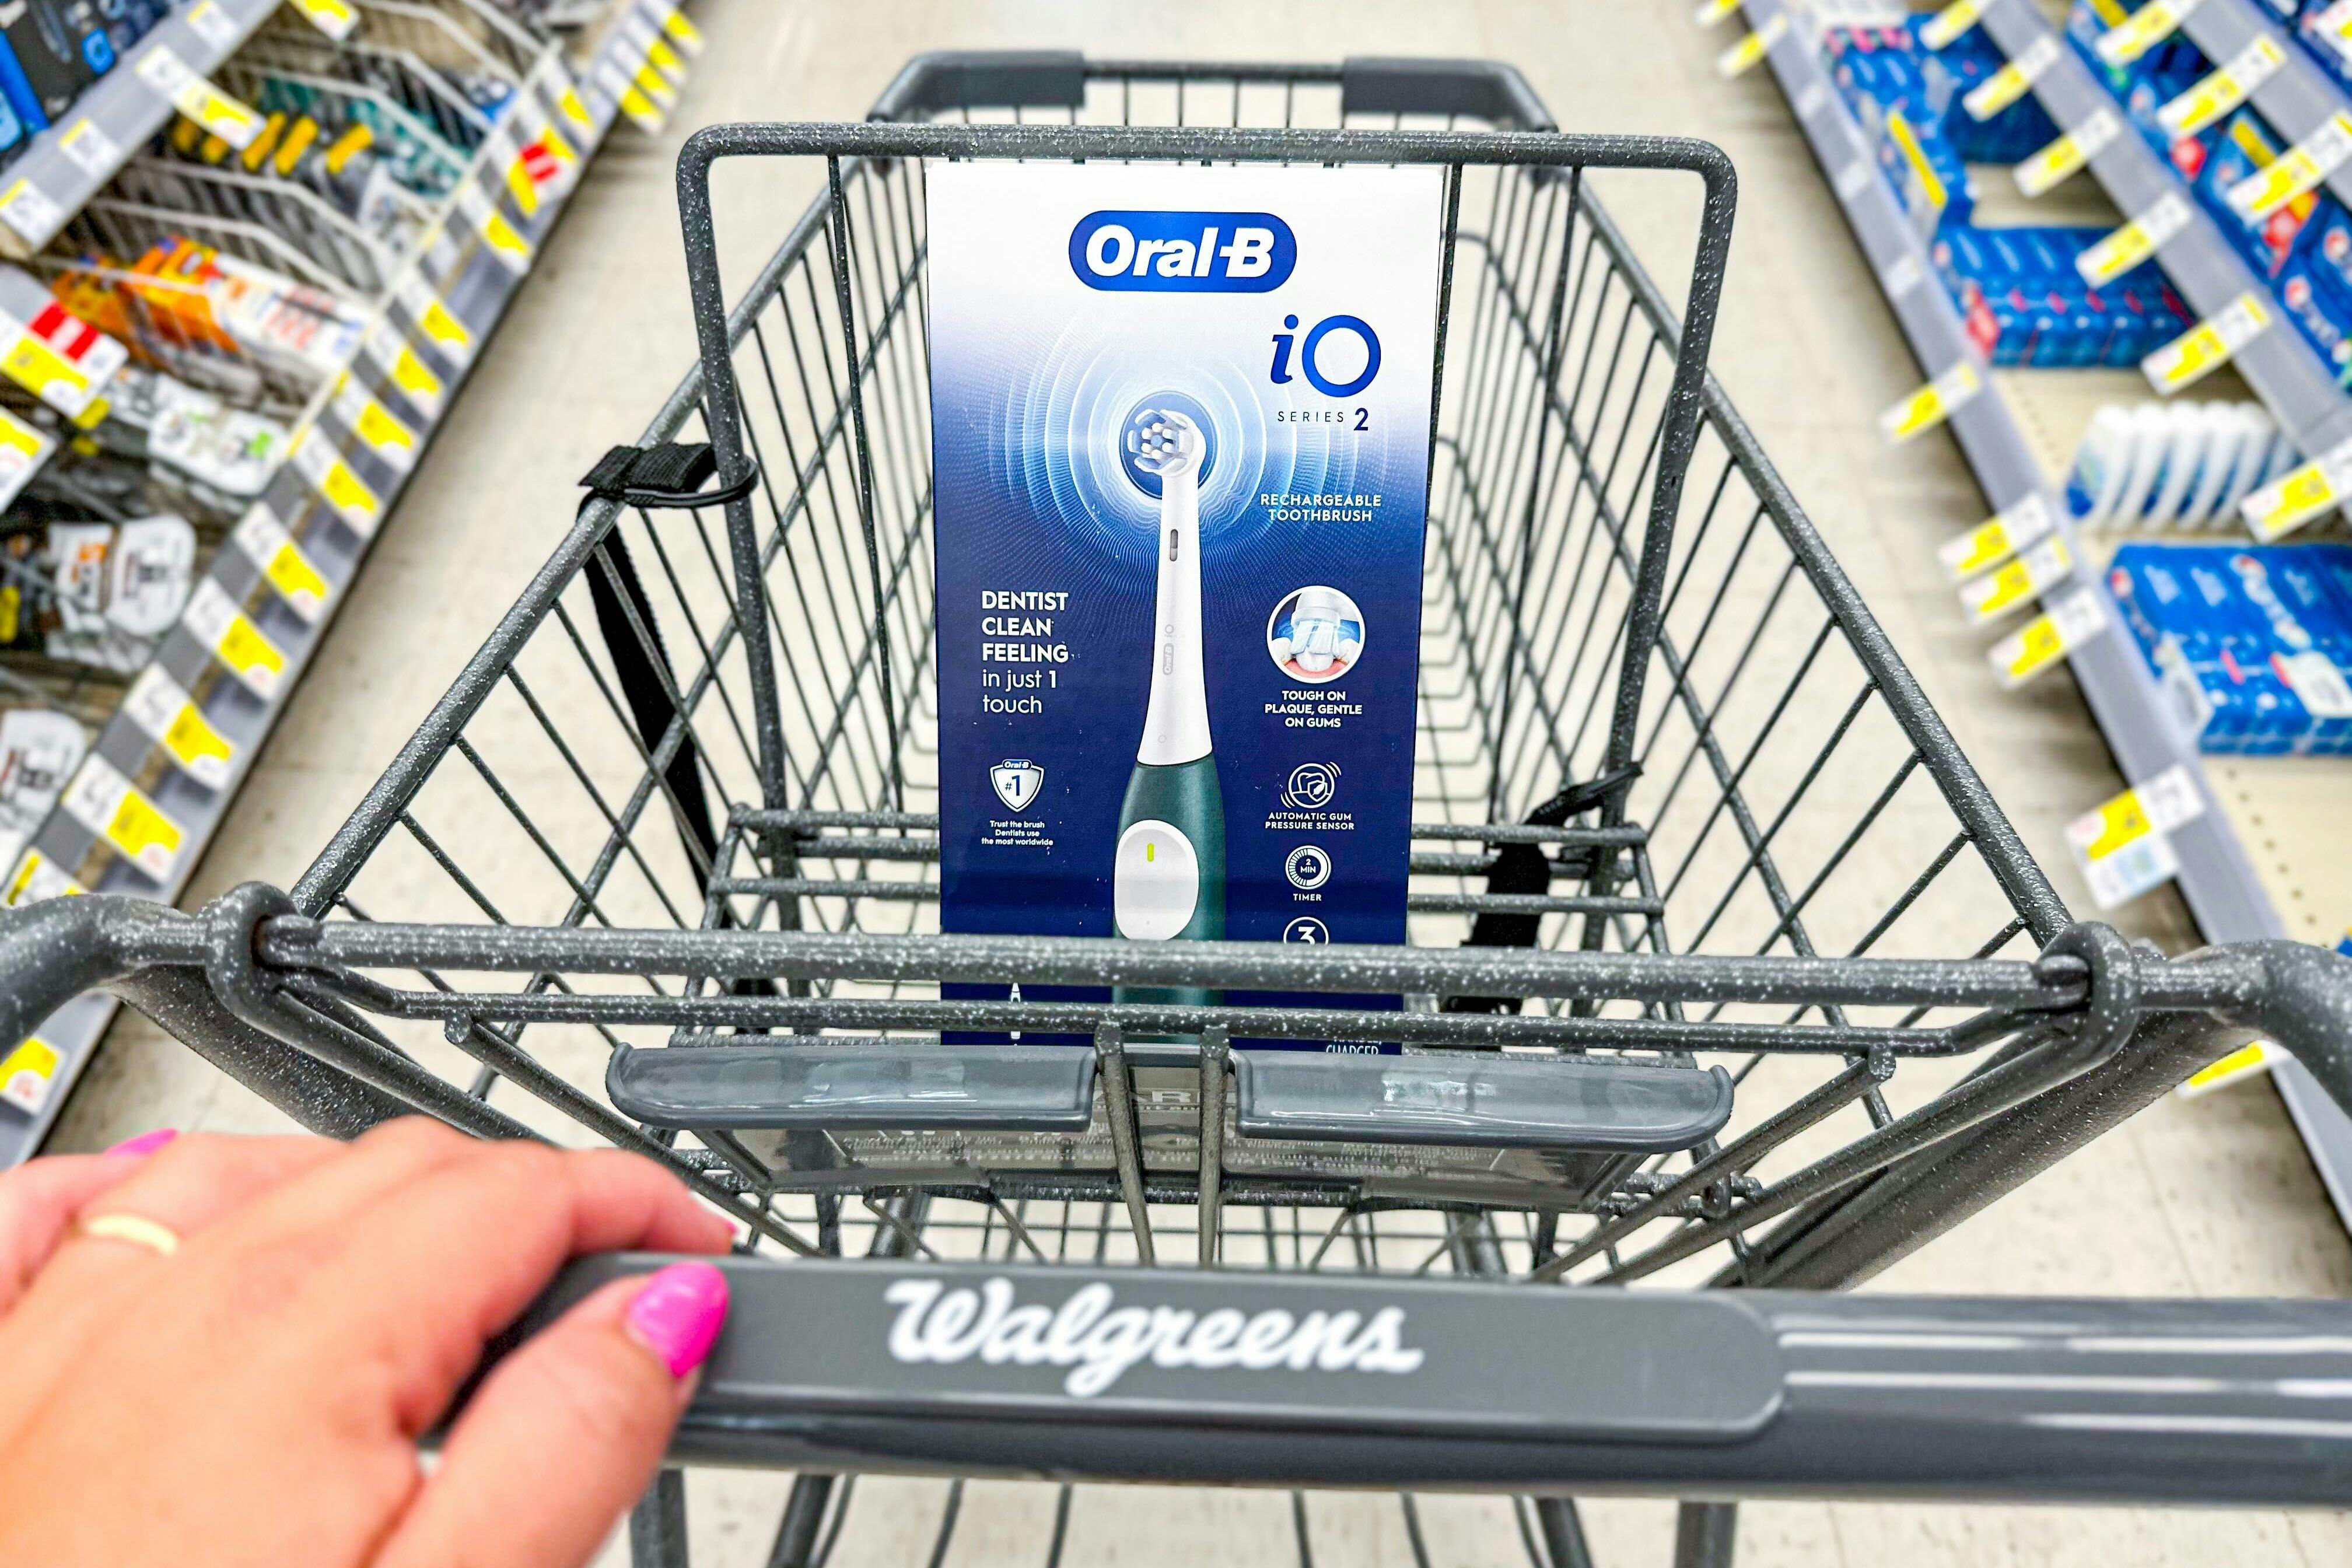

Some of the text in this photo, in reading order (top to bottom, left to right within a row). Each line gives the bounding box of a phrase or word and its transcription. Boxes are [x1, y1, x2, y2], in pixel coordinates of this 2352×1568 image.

[1086, 225, 1274, 278] Oral-B
[1270, 314, 1381, 397] iO
[1278, 407, 1368, 430] SERIES 2
[1261, 494, 1381, 506] RECHARGEABLE
[1268, 509, 1372, 522] TOOTHBRUSH
[982, 590, 1069, 611] DENTIST
[982, 617, 1051, 636] CLEAN
[982, 643, 1069, 663] FEELING
[983, 669, 1056, 692] in just 1
[983, 694, 1042, 713] touch
[1282, 691, 1346, 701] TOUGH ON
[1265, 704, 1363, 715] PLAQUE, GENTLE
[1285, 718, 1341, 727] ON GUMS
[1005, 775, 1020, 796] #1
[1265, 821, 1354, 830] PRESSURE SENSOR
[1268, 812, 1352, 821] AUTOMATIC GUM
[1293, 893, 1322, 901] TIMER
[885, 1277, 1424, 1398] Walgreens
